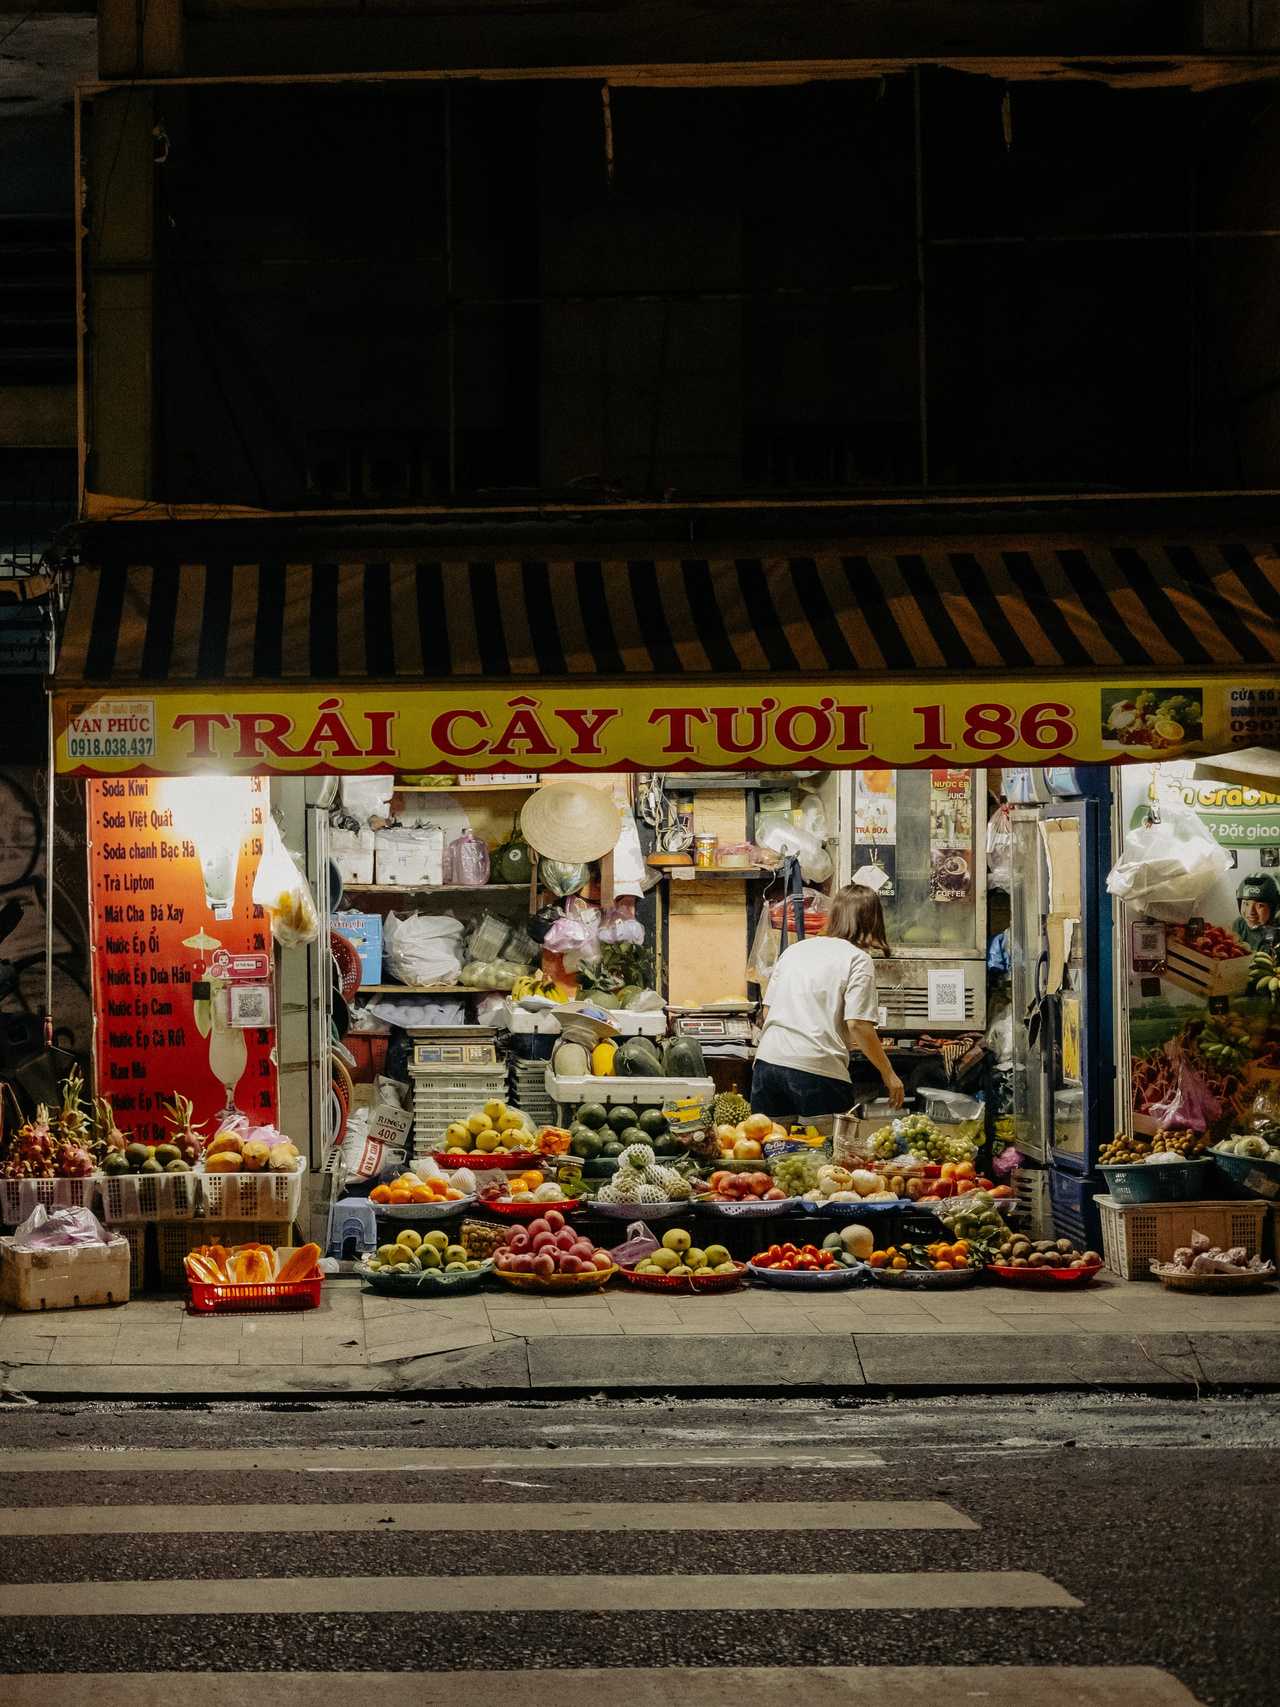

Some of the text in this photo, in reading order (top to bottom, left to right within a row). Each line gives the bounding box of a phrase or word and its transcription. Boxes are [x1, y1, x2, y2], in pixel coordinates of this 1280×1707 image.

[1231, 687, 1256, 701] CỬA
[70, 714, 150, 736] VẠN PHÚC
[171, 695, 1080, 758] TRÁI CÂY TƯƠI 186
[71, 737, 153, 756] 0918.038.437
[102, 780, 125, 797] Soda
[128, 779, 149, 796] Kiwi
[934, 780, 957, 788] NƯỚC
[103, 808, 263, 831] Soda Việt Quất 15k
[1219, 824, 1244, 840] Đặt
[103, 838, 263, 861] Soda chanh Bạc Hà 15k
[104, 873, 155, 893] Trà Lipton
[936, 890, 966, 898] COFFEE
[104, 905, 123, 923] Mát
[126, 905, 145, 922] Cha
[150, 904, 164, 922] Đá
[167, 903, 184, 924] Xay
[105, 926, 266, 956] Nước Ép Ổi 20k
[106, 962, 191, 987] Nước Ép Dưa Hấu
[108, 994, 172, 1018] Nước Ép Cam
[109, 1031, 133, 1048] Nước
[136, 1025, 149, 1050] Ép
[152, 1029, 165, 1047] Cà
[168, 1027, 186, 1047] Rốt
[110, 1059, 270, 1079] Rau Má 15k
[111, 1093, 135, 1110] Nước
[139, 1087, 152, 1113] Ép
[377, 1115, 407, 1130] RINGO
[378, 1128, 397, 1141] 400
